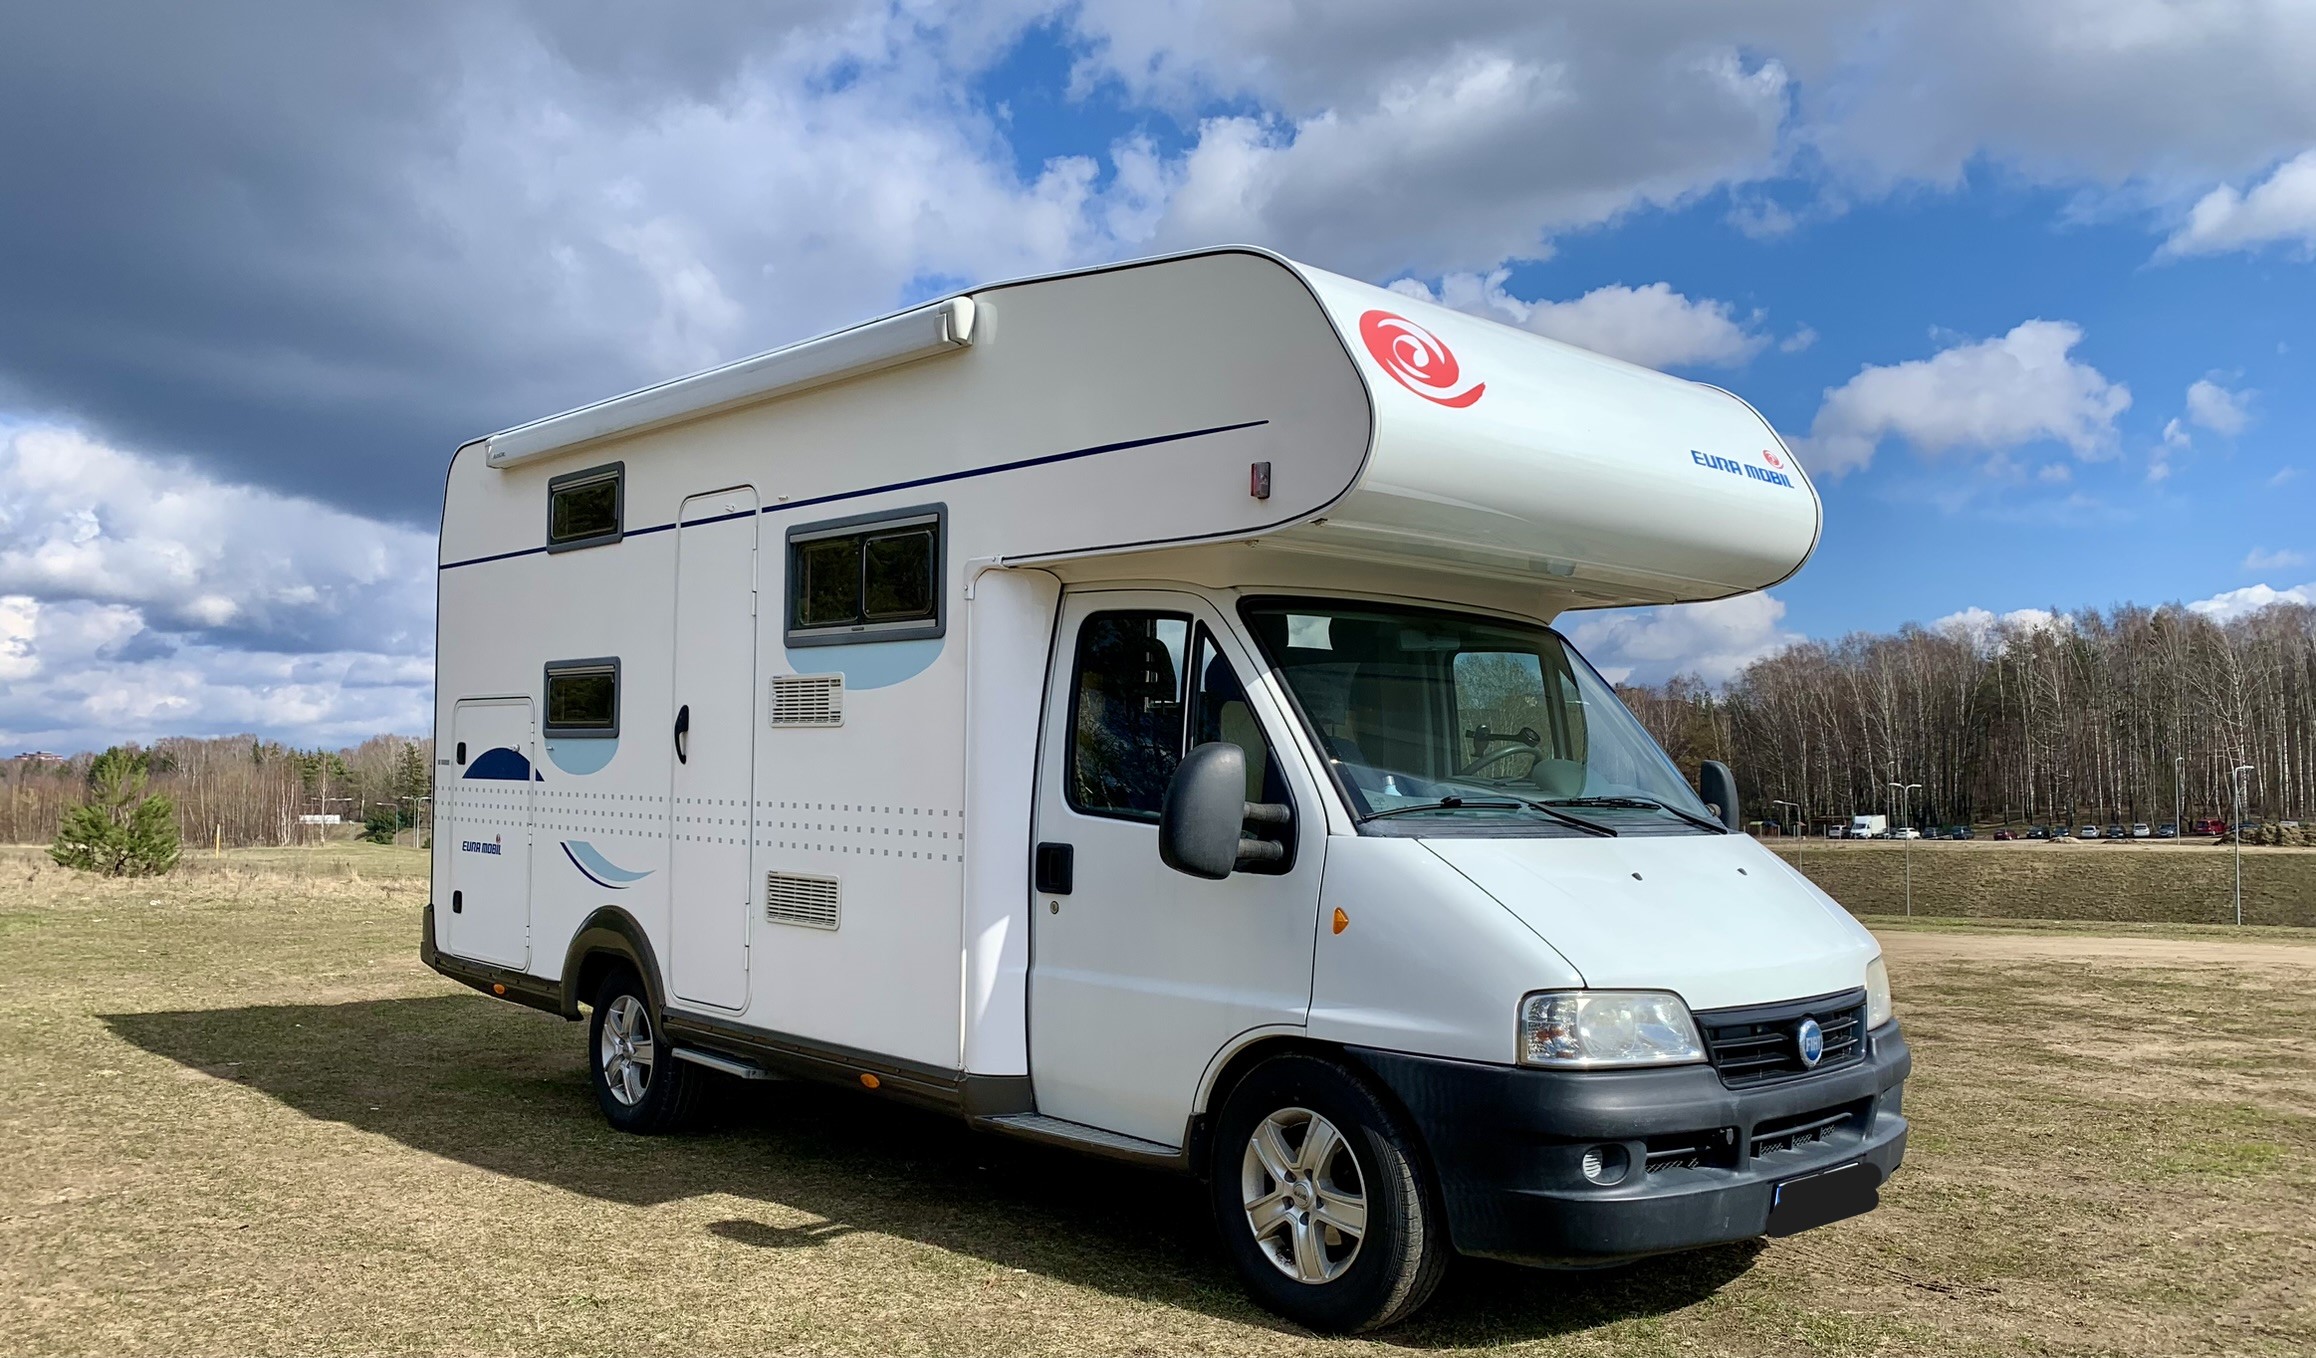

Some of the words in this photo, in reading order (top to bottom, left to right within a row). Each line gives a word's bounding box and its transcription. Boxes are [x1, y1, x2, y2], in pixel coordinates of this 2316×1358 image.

[1691, 450, 1743, 476] EURA
[1744, 464, 1795, 488] MOBIL
[462, 840, 481, 852] EURA
[481, 843, 501, 855] MOBIL
[1806, 1036, 1820, 1052] FIAT
